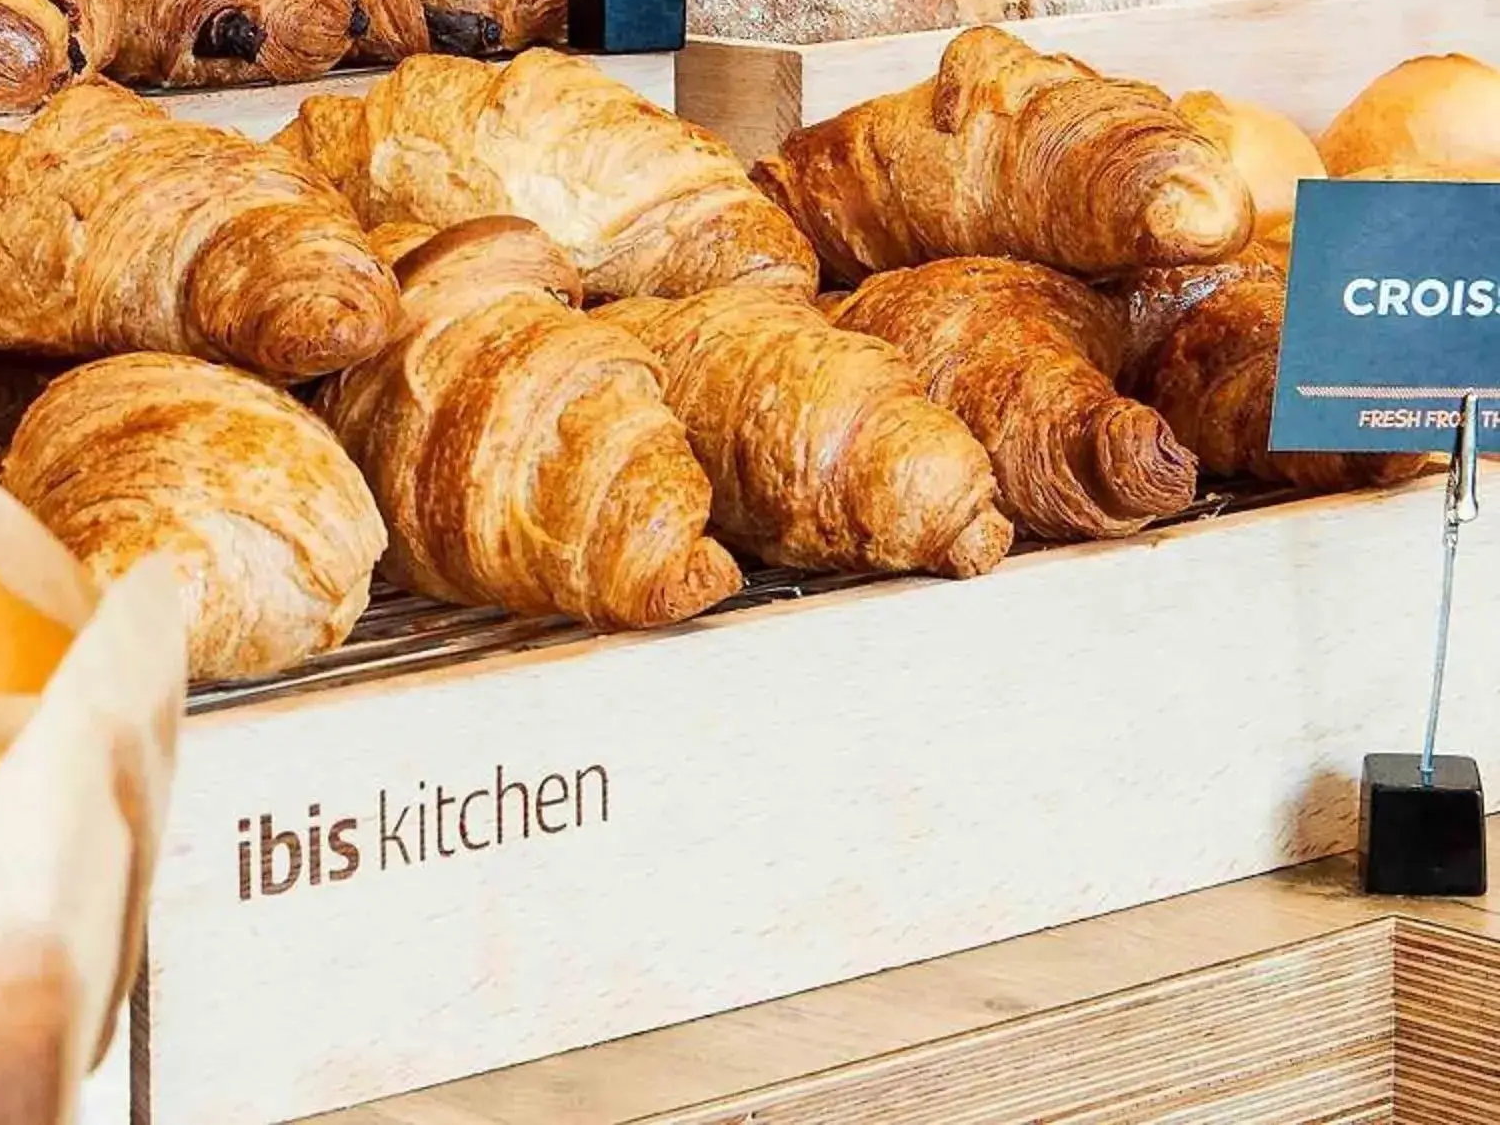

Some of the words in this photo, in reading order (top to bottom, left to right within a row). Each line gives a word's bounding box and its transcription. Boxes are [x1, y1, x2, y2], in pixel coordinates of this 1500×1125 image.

[1343, 278, 1500, 317] CROIS
[1358, 408, 1421, 429] FRESH
[1424, 409, 1468, 429] FRO
[238, 803, 360, 901] ibis
[379, 763, 609, 872] kitchen
